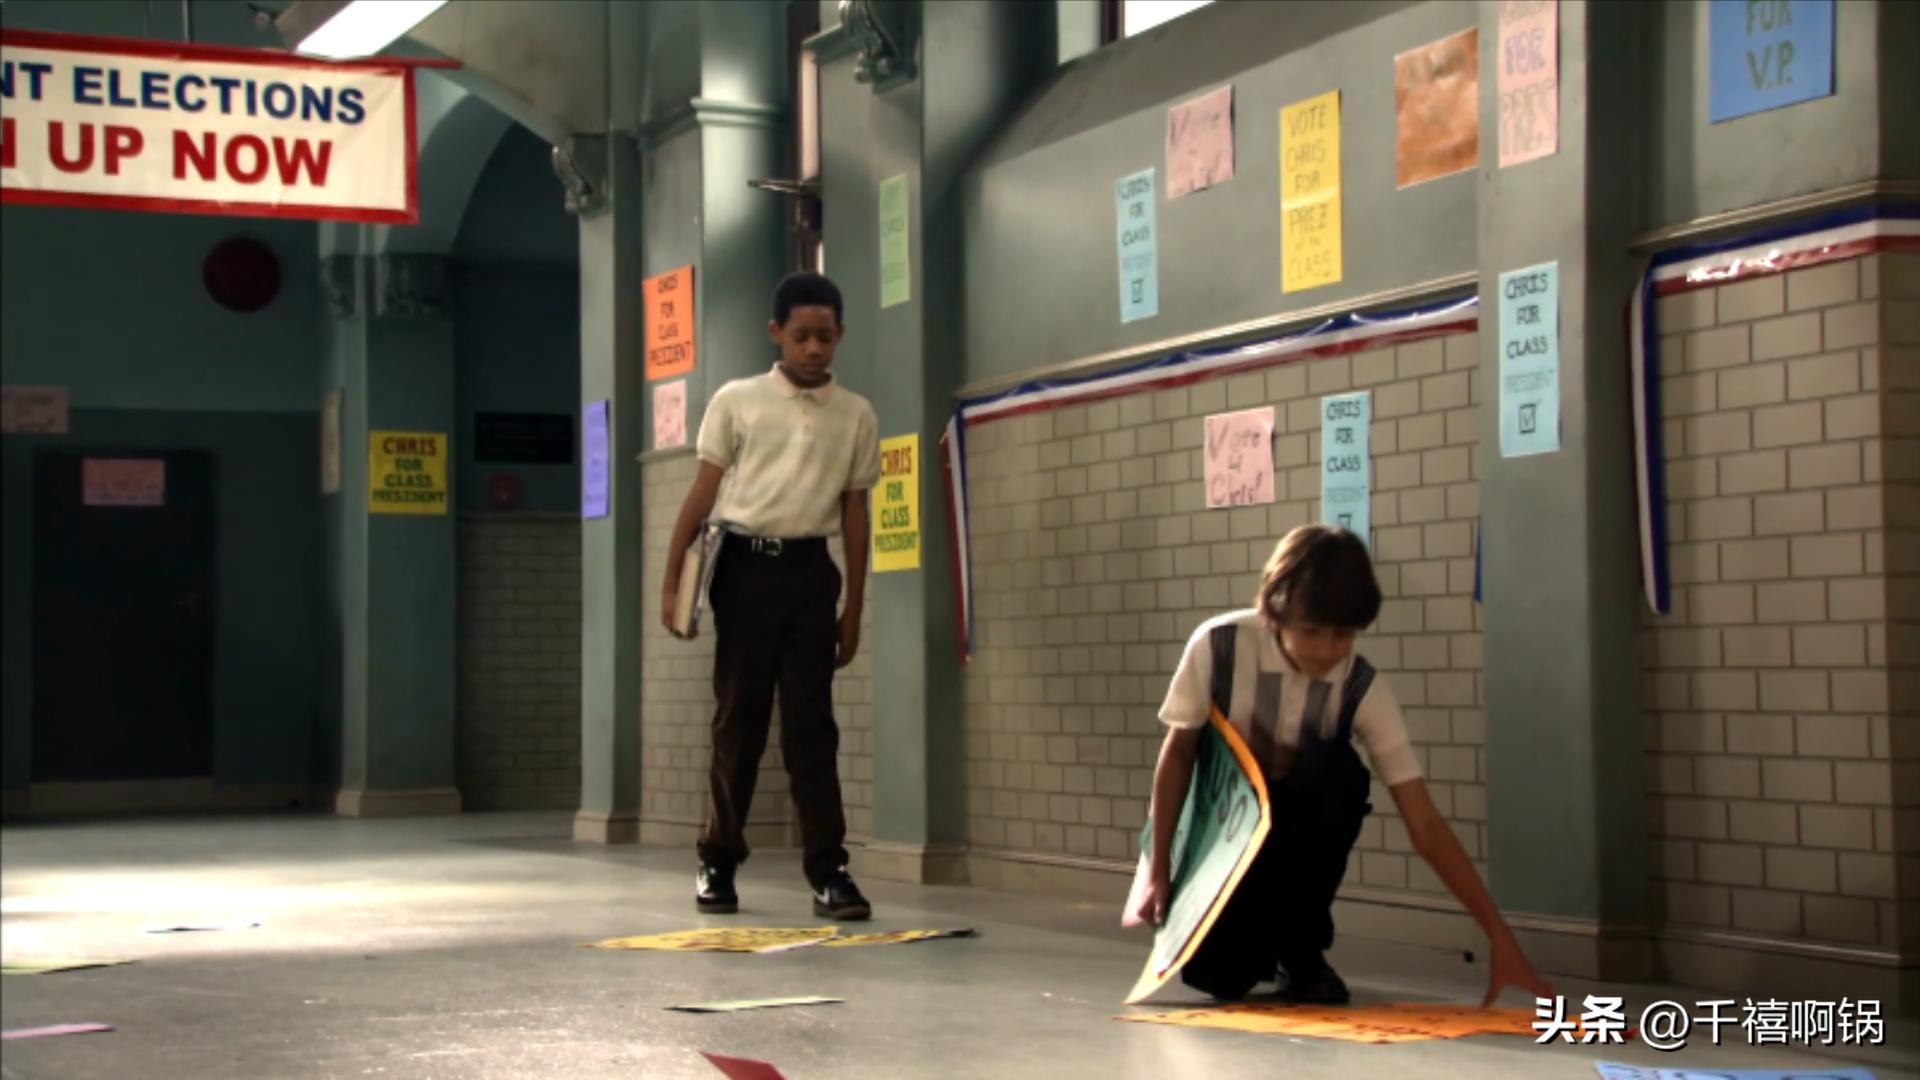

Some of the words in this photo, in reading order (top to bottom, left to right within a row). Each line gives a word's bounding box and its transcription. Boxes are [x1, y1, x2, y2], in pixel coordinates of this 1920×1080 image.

[73, 66, 366, 124] ELECTIONS
[1288, 104, 1327, 137] VOTE
[48, 121, 144, 175] UP
[172, 129, 332, 187] NOW
[1285, 139, 1326, 172] CHRIS
[1295, 170, 1320, 195] FOR
[1289, 203, 1328, 236] PREZ
[1121, 225, 1150, 246] CLASS
[1290, 249, 1331, 280] CLASS
[1504, 273, 1548, 300] CHRIS
[1516, 305, 1541, 325] FOR
[1506, 336, 1548, 359] CLASS
[1326, 400, 1361, 421] CHRIS
[383, 437, 437, 456] CHRIS
[1335, 427, 1354, 445] FOR
[395, 457, 423, 471] FOR
[881, 445, 911, 477] CHRIS
[1326, 455, 1361, 473] CLASS
[384, 473, 433, 488] CLASS
[886, 480, 904, 503] FOR
[372, 488, 445, 504] PRESIDENT
[881, 505, 911, 529] CLASS
[875, 531, 918, 553] PRESIDENT
